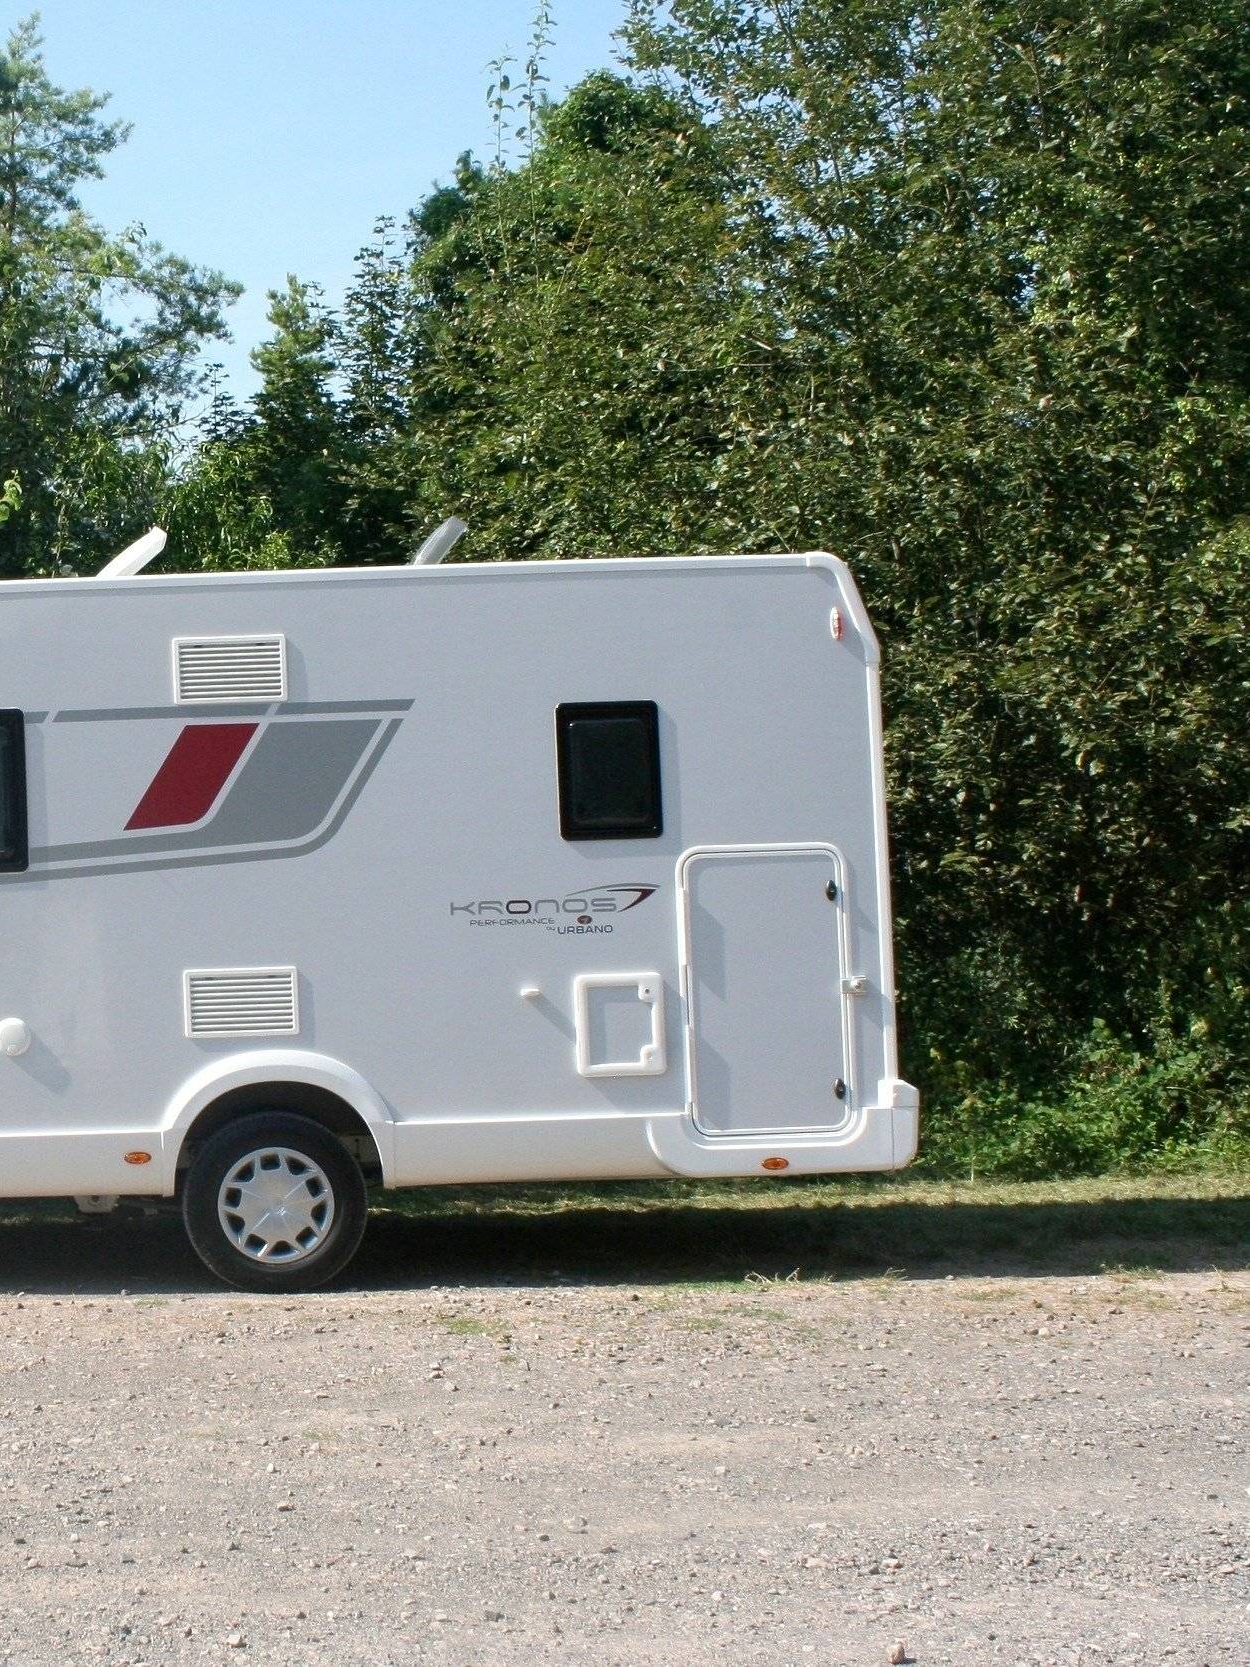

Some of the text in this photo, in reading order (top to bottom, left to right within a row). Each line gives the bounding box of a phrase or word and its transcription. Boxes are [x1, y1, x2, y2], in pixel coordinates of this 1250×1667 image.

[450, 897, 617, 916] KRONOS
[469, 918, 555, 927] PERFORMANCE
[557, 924, 613, 935] URBANO
